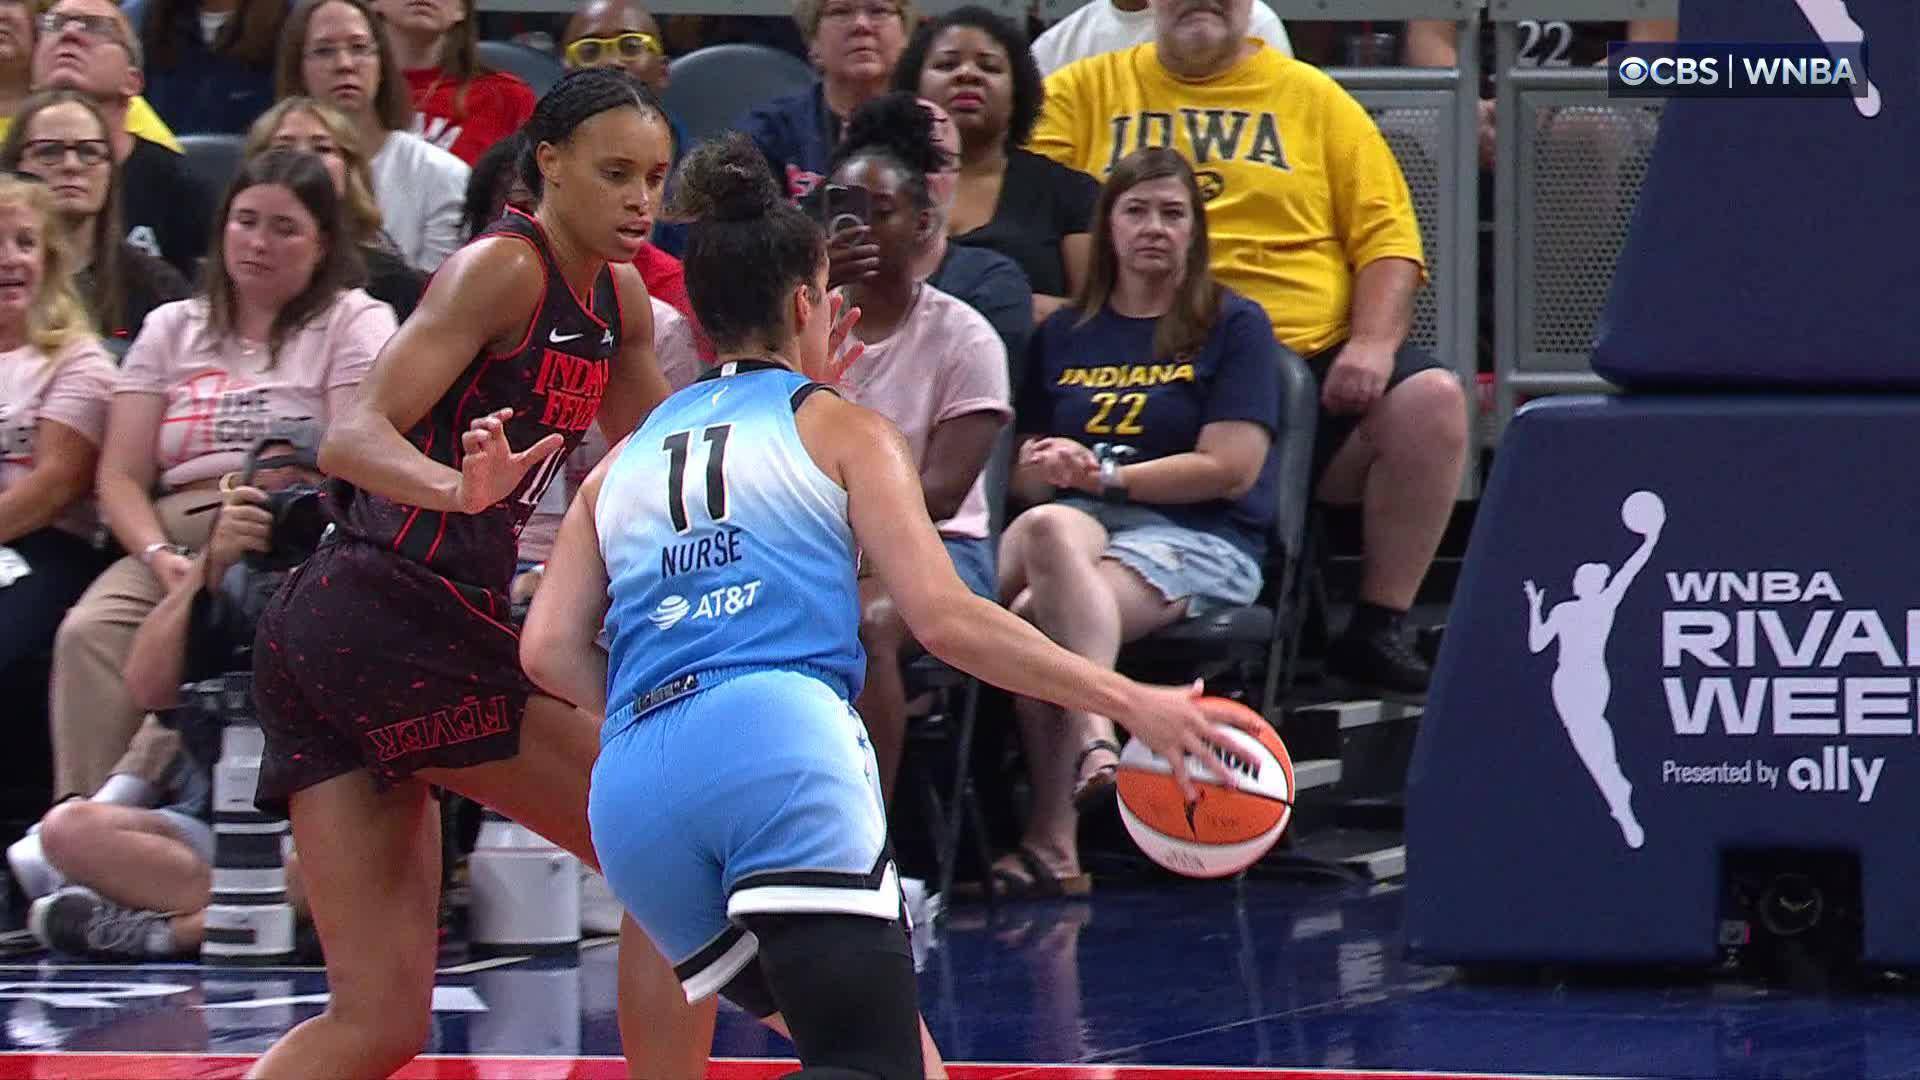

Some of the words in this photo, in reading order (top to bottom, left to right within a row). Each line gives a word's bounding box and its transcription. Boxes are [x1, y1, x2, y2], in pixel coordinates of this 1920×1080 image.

[1517, 20, 1572, 66] 22
[1104, 108, 1291, 172] IOWA
[1057, 364, 1195, 388] INDIANA
[1085, 392, 1148, 435] 22
[662, 423, 734, 534] 11
[661, 528, 743, 579] NURSE
[691, 580, 762, 620] AT&T
[1665, 571, 1844, 602] WNBA
[1662, 609, 1920, 668] RIVA
[1662, 677, 1920, 735] WEE
[1663, 760, 1752, 784] Presented
[1756, 759, 1780, 790] by
[1787, 745, 1886, 803] ally
